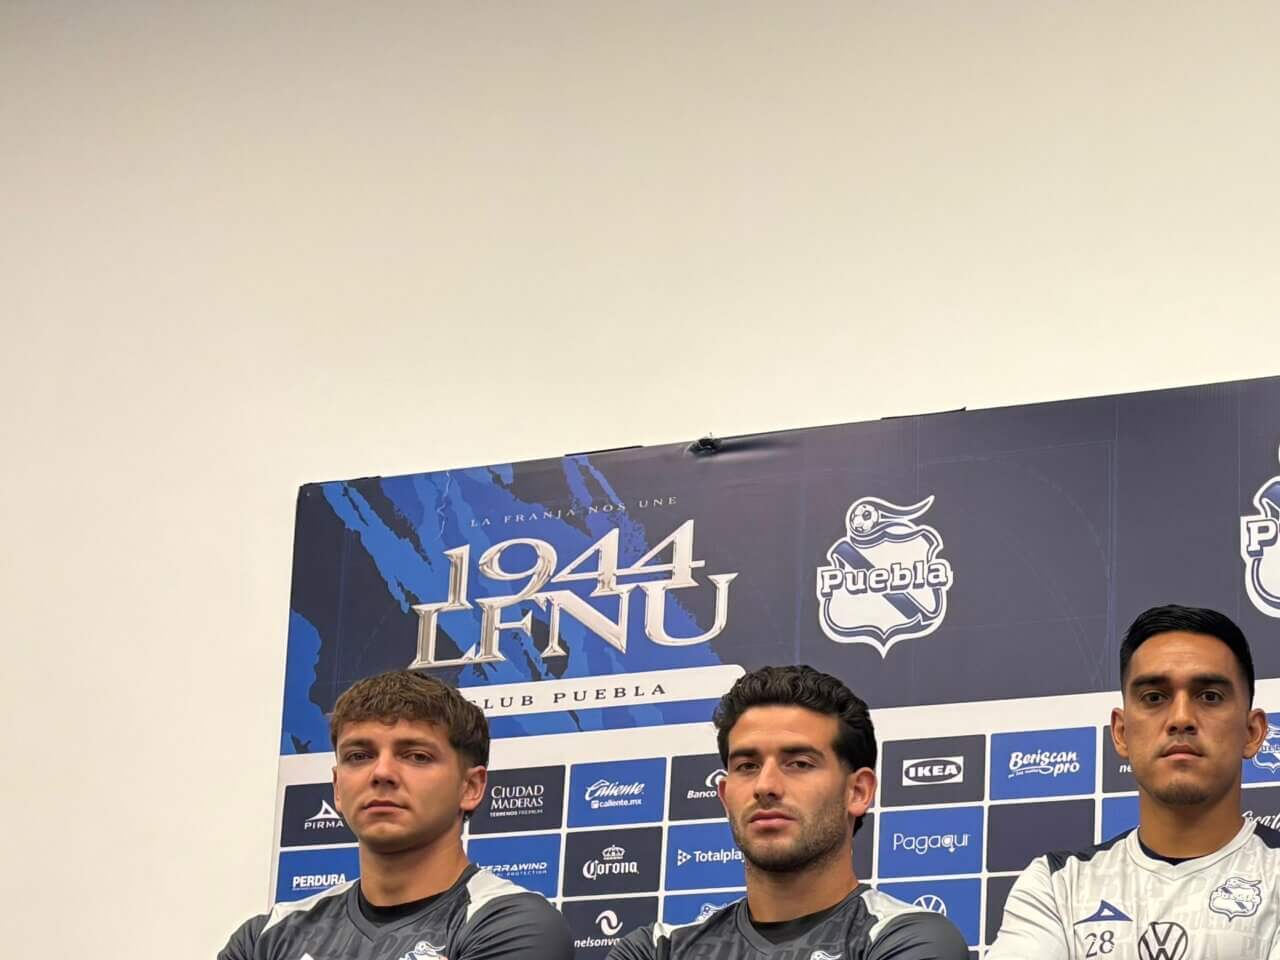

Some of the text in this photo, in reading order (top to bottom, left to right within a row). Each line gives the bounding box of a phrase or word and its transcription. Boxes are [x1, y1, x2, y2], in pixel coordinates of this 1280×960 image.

[471, 496, 678, 528] LA FRANJA NOS UNE
[443, 518, 706, 609] 1944
[819, 559, 951, 598] Puebla
[406, 571, 739, 670] LFNU
[474, 683, 667, 709] LUB PUEBLA
[1009, 751, 1077, 770] Beriscan
[1054, 760, 1080, 777] pro
[908, 764, 958, 778] IKEA
[491, 784, 544, 799] CIUDAD
[583, 779, 645, 801] Caliente
[687, 789, 717, 799] Banco
[490, 797, 544, 810] MADERAS
[599, 797, 643, 808] caliente.mx
[304, 818, 344, 830] PIRMA
[582, 859, 639, 881] Corona
[292, 873, 347, 888] PERDURA
[573, 936, 621, 949] nelsonva
[1084, 930, 1115, 959] 28
